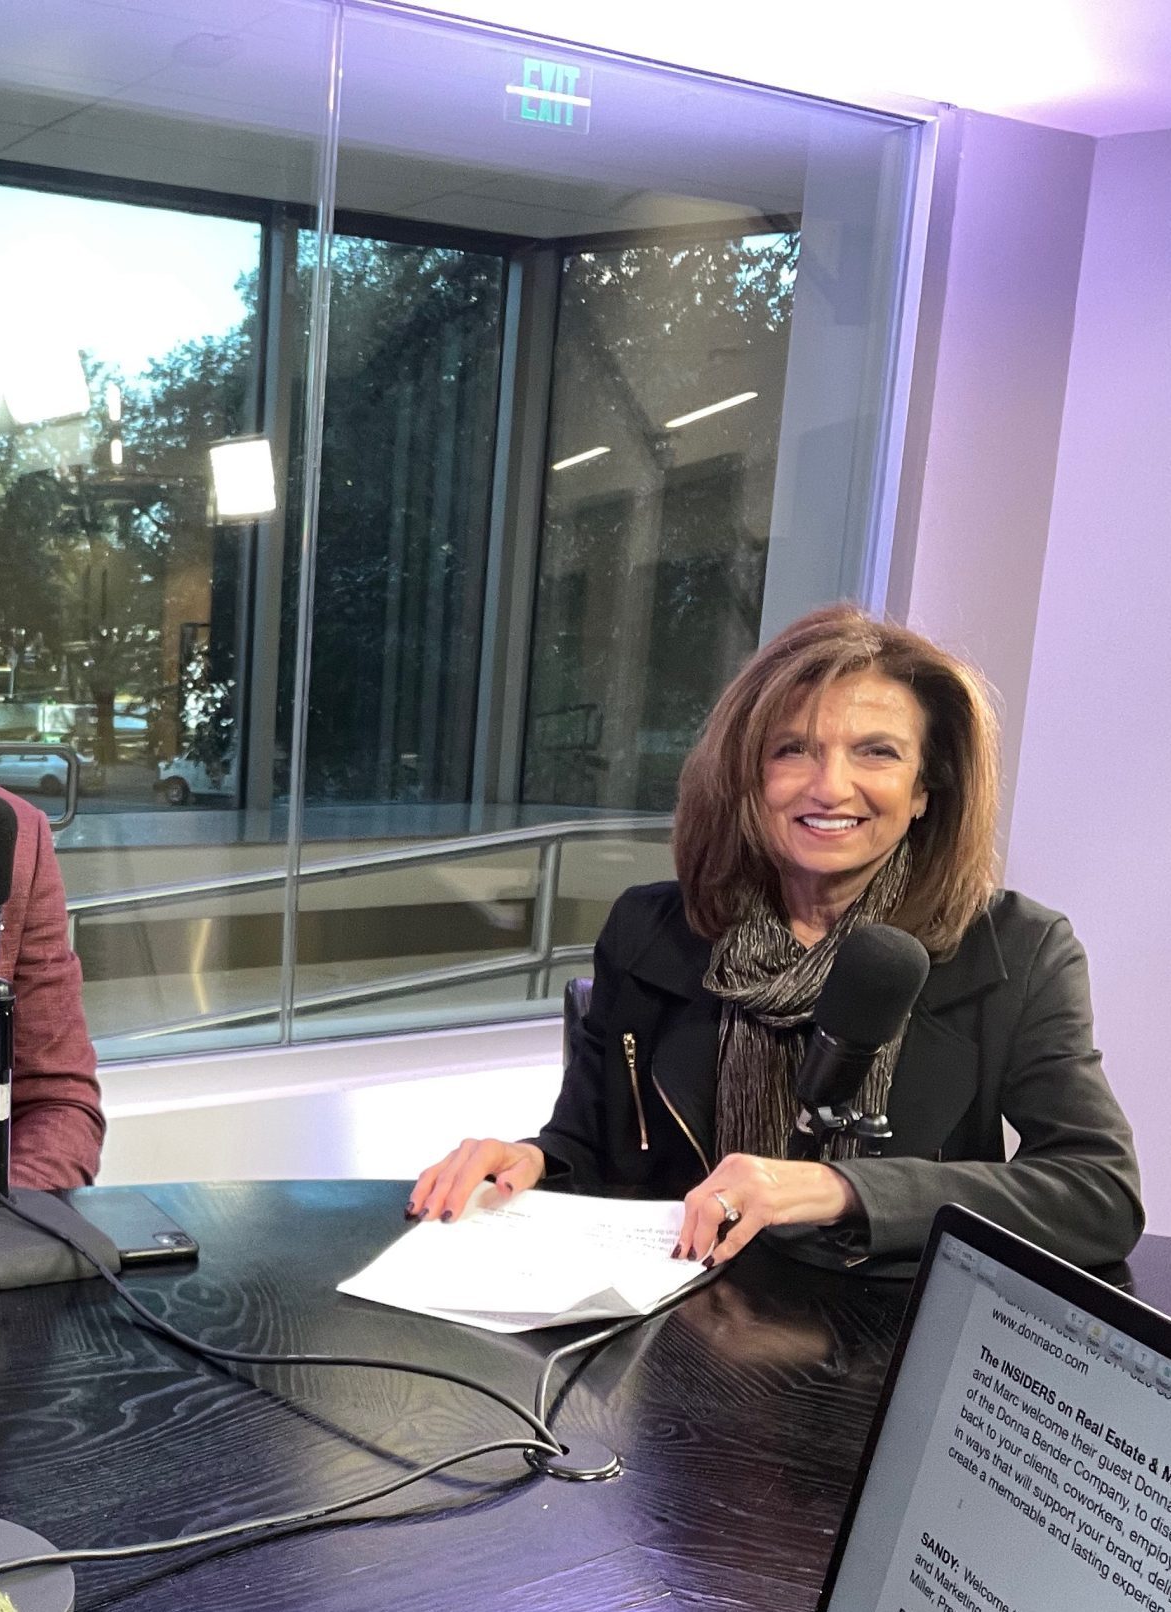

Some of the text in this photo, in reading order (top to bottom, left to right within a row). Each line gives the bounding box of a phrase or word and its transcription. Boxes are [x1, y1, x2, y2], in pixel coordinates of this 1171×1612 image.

[521, 57, 581, 126] EXIT
[992, 1308, 1089, 1375] www.donnaco.com
[967, 1389, 979, 1402] of
[979, 1394, 995, 1414] the
[996, 1406, 1030, 1439] Donna
[1032, 1430, 1072, 1467] Bender
[1074, 1461, 1130, 1513] Company,
[1135, 1503, 1148, 1522] to
[972, 1369, 993, 1388] and
[993, 1379, 1019, 1406] Marc
[1021, 1401, 1069, 1440] welcome
[1071, 1432, 1098, 1459] their
[1097, 1454, 1133, 1485] guest
[980, 1345, 999, 1368] The
[1001, 1360, 1057, 1405] INSIDERS
[1057, 1401, 1073, 1418] on
[1075, 1408, 1104, 1437] Real
[1105, 1427, 1146, 1465] Estate
[1149, 1457, 1159, 1475] &
[948, 1446, 978, 1475] create
[979, 1470, 987, 1482] a
[988, 1476, 1046, 1527] memorable
[1048, 1523, 1070, 1546] and
[1071, 1537, 1110, 1580] lasting
[954, 1424, 964, 1440] in
[965, 1434, 990, 1460] ways
[992, 1453, 1012, 1477] that
[1014, 1471, 1032, 1491] will
[1033, 1486, 1076, 1524] support
[1076, 1518, 1105, 1544] your
[1105, 1536, 1143, 1579] brand,
[960, 1404, 985, 1431] back
[986, 1424, 997, 1440] to
[997, 1434, 1022, 1457] your
[1023, 1453, 1059, 1489] clients,
[1063, 1482, 1125, 1537] coworkers,
[909, 1569, 935, 1604] Miller,
[915, 1554, 934, 1575] and
[920, 1532, 1010, 1612] SANDY: Welcome
